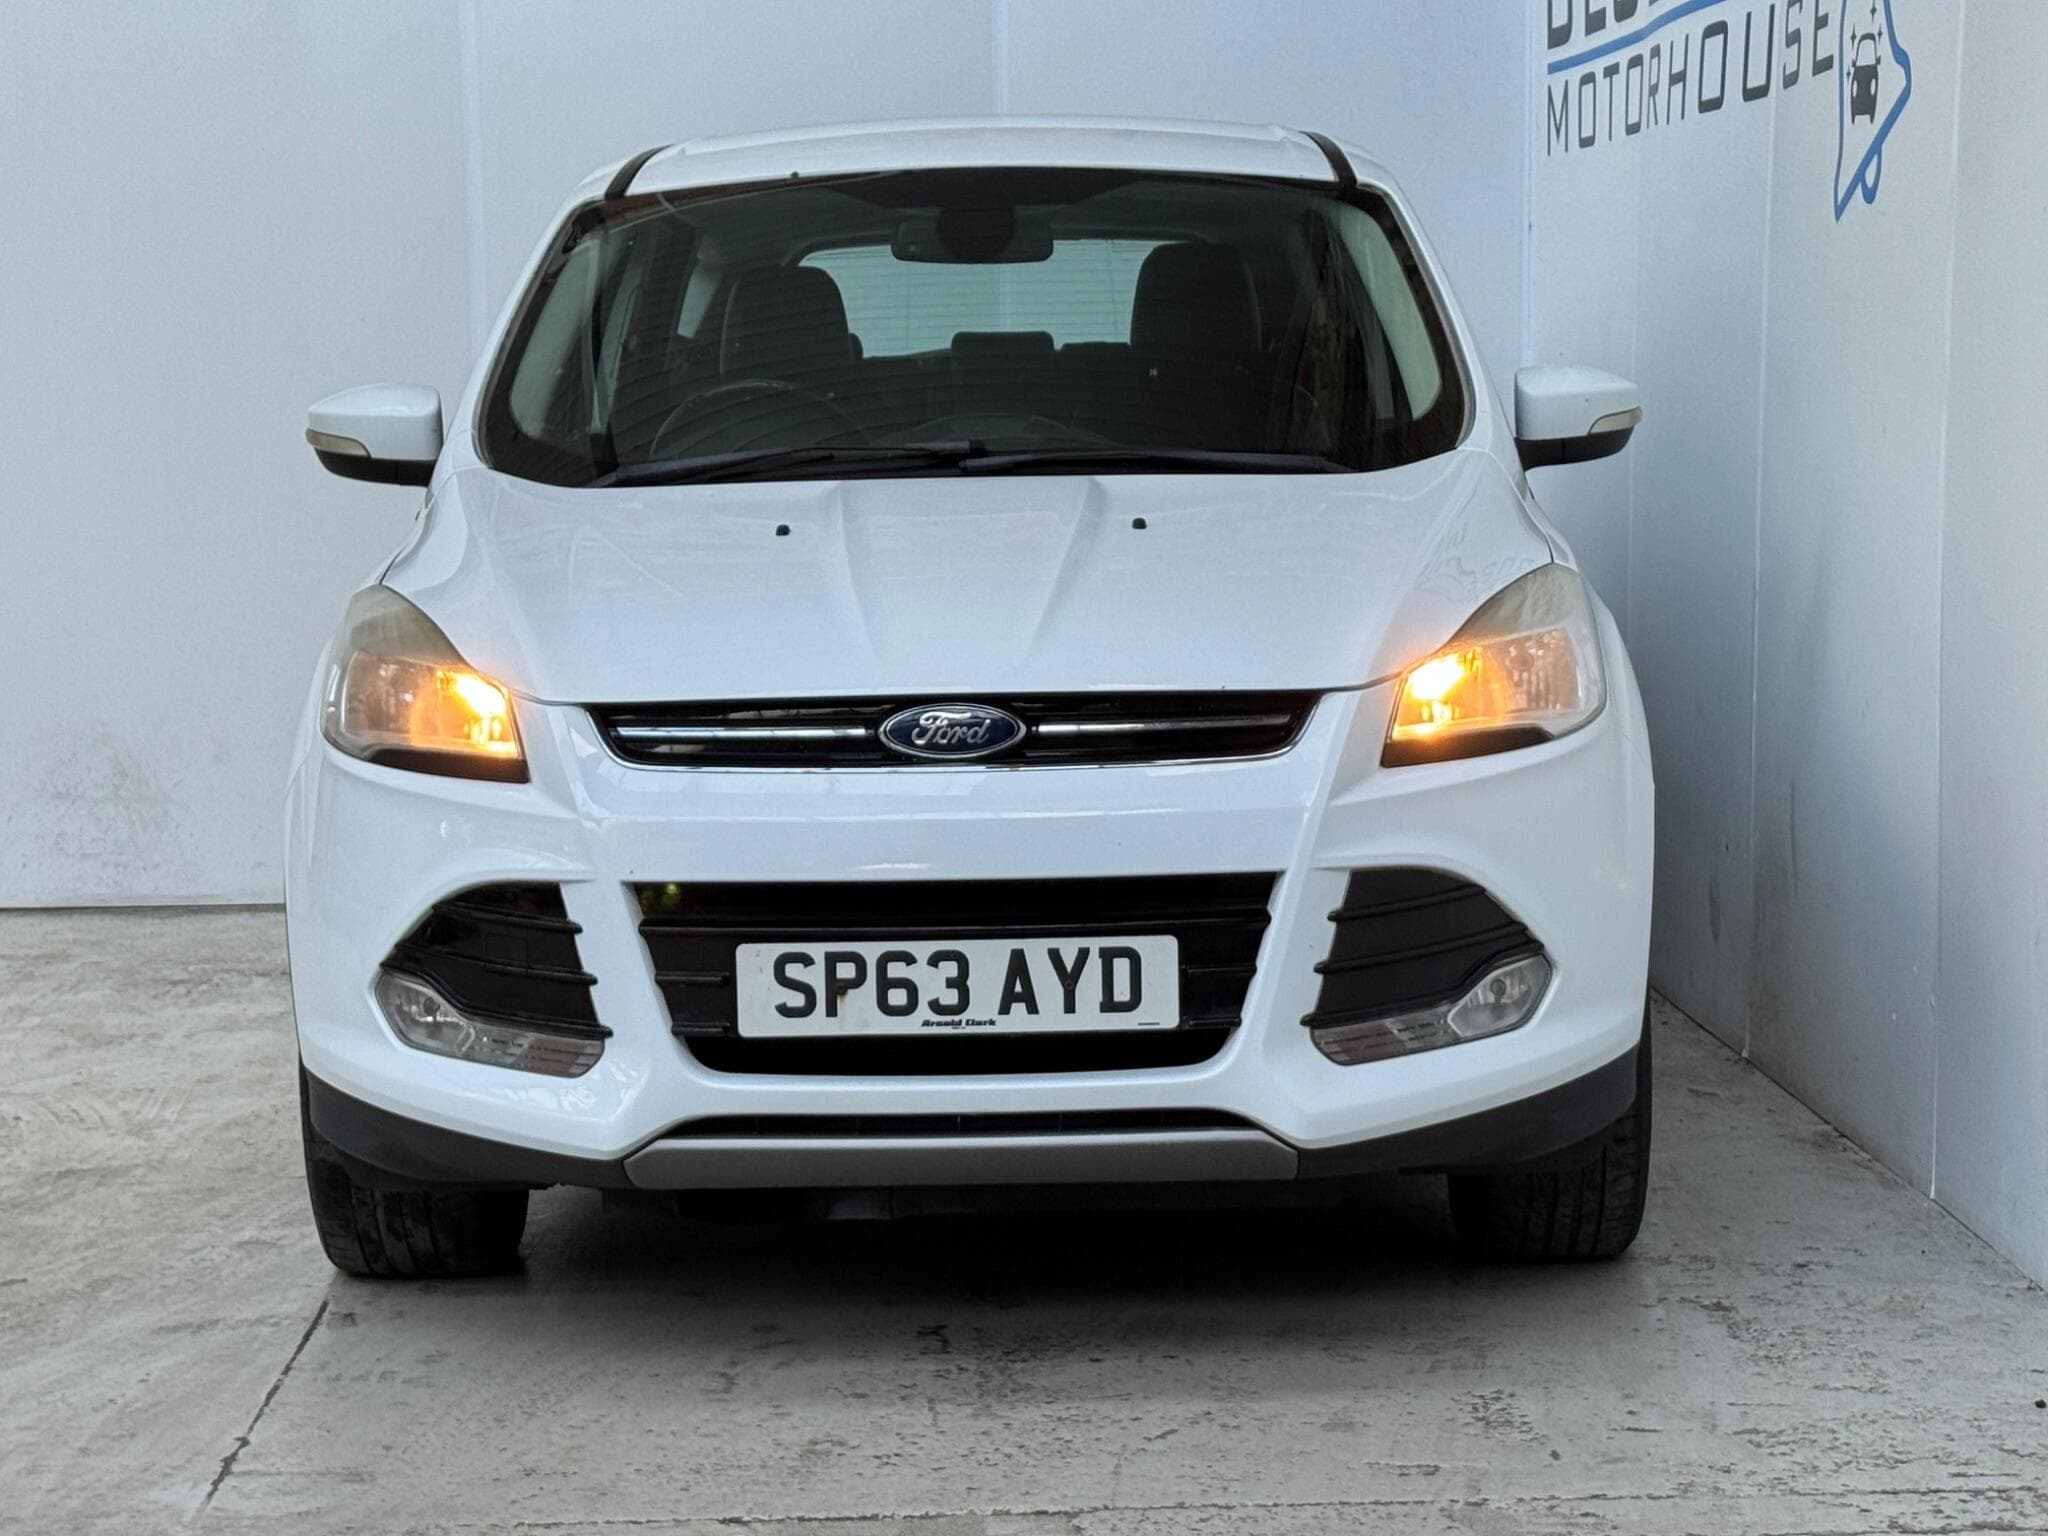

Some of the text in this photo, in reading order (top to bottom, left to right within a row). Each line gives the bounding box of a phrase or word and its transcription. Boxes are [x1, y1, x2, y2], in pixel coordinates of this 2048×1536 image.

[1547, 0, 1834, 157] MOTORHOUSE
[911, 711, 992, 745] Ford
[773, 945, 1142, 1019] SP63 AYD
